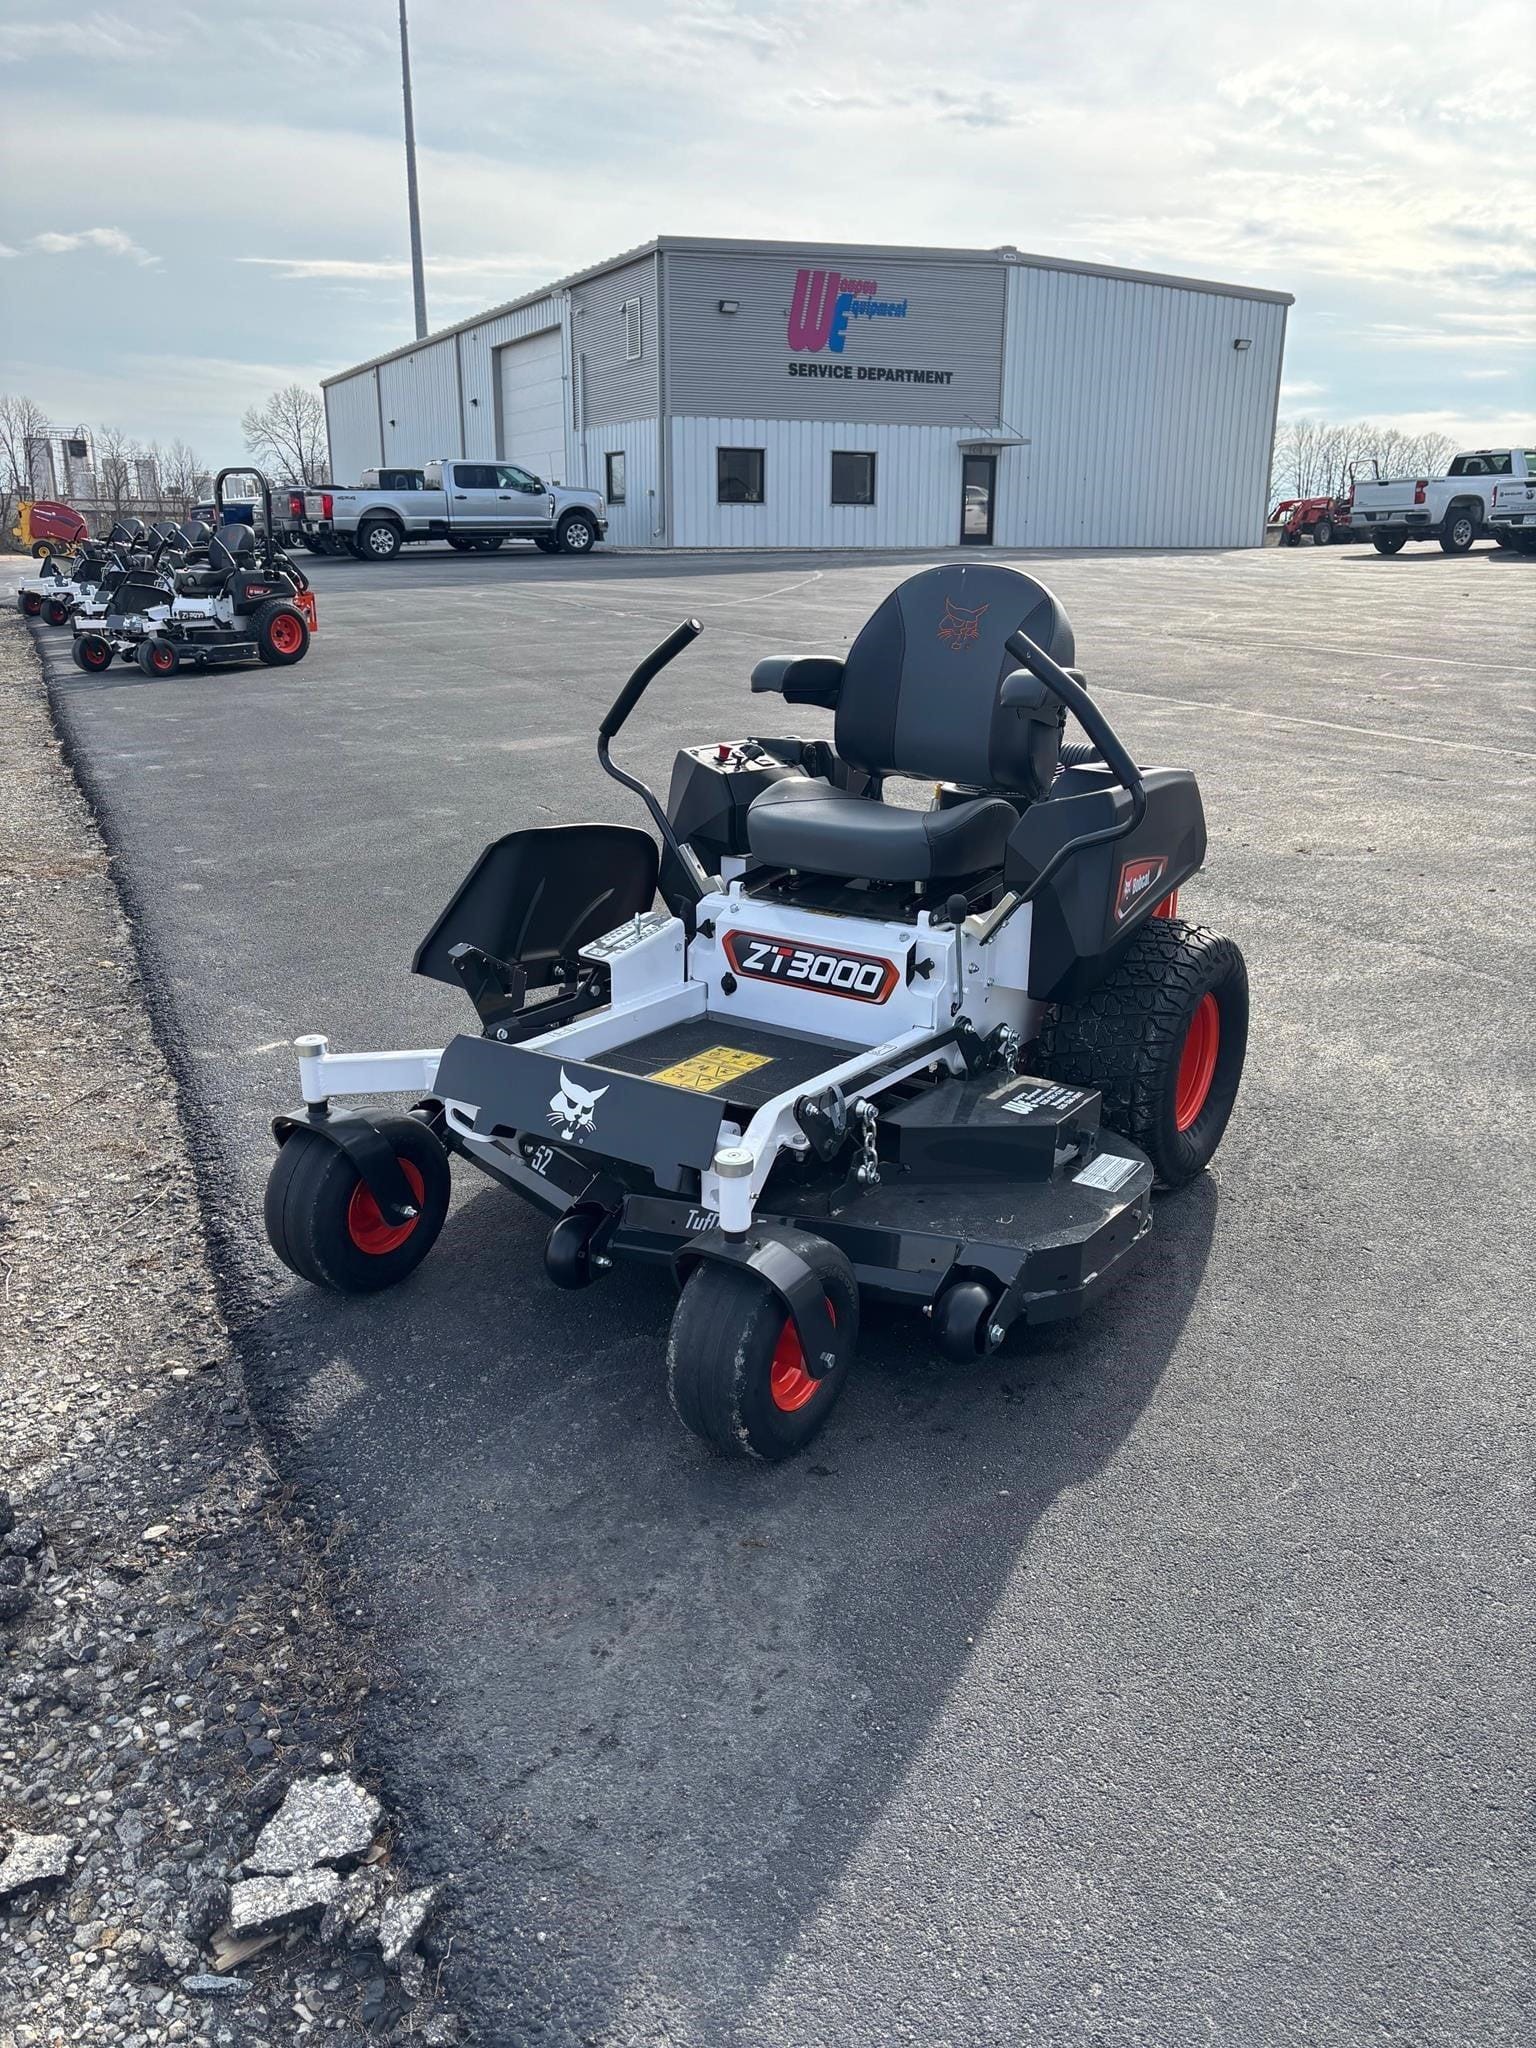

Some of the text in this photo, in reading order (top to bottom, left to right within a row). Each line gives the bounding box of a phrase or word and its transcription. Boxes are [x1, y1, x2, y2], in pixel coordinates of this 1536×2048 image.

[788, 362, 953, 384] SERVICE DEPARTMENT
[742, 941, 884, 994] ZT3000
[531, 1145, 553, 1176] 52
